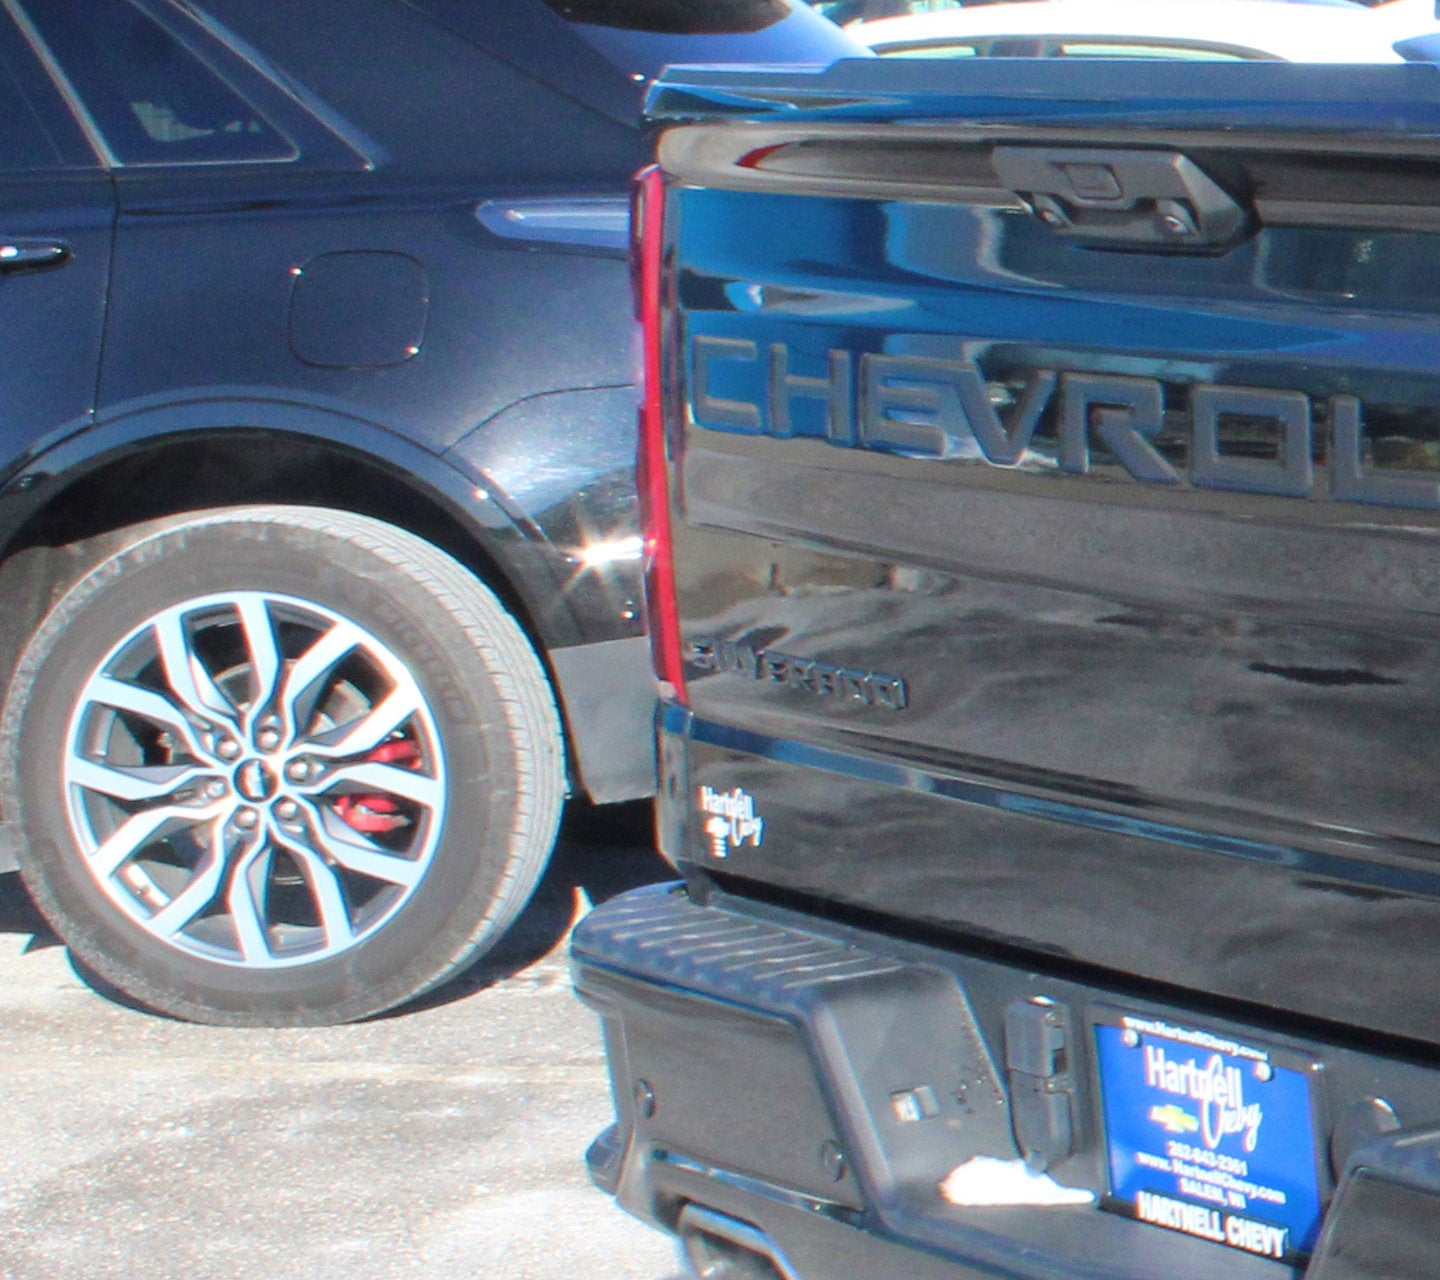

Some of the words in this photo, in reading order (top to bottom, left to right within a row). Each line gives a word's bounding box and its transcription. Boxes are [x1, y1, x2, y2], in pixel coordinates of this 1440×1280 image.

[687, 637, 910, 710] SILVERADO
[1144, 1045, 1243, 1110] Hartnell
[1136, 1190, 1227, 1242] HARTNELL
[1227, 1215, 1288, 1259] CHEVY
